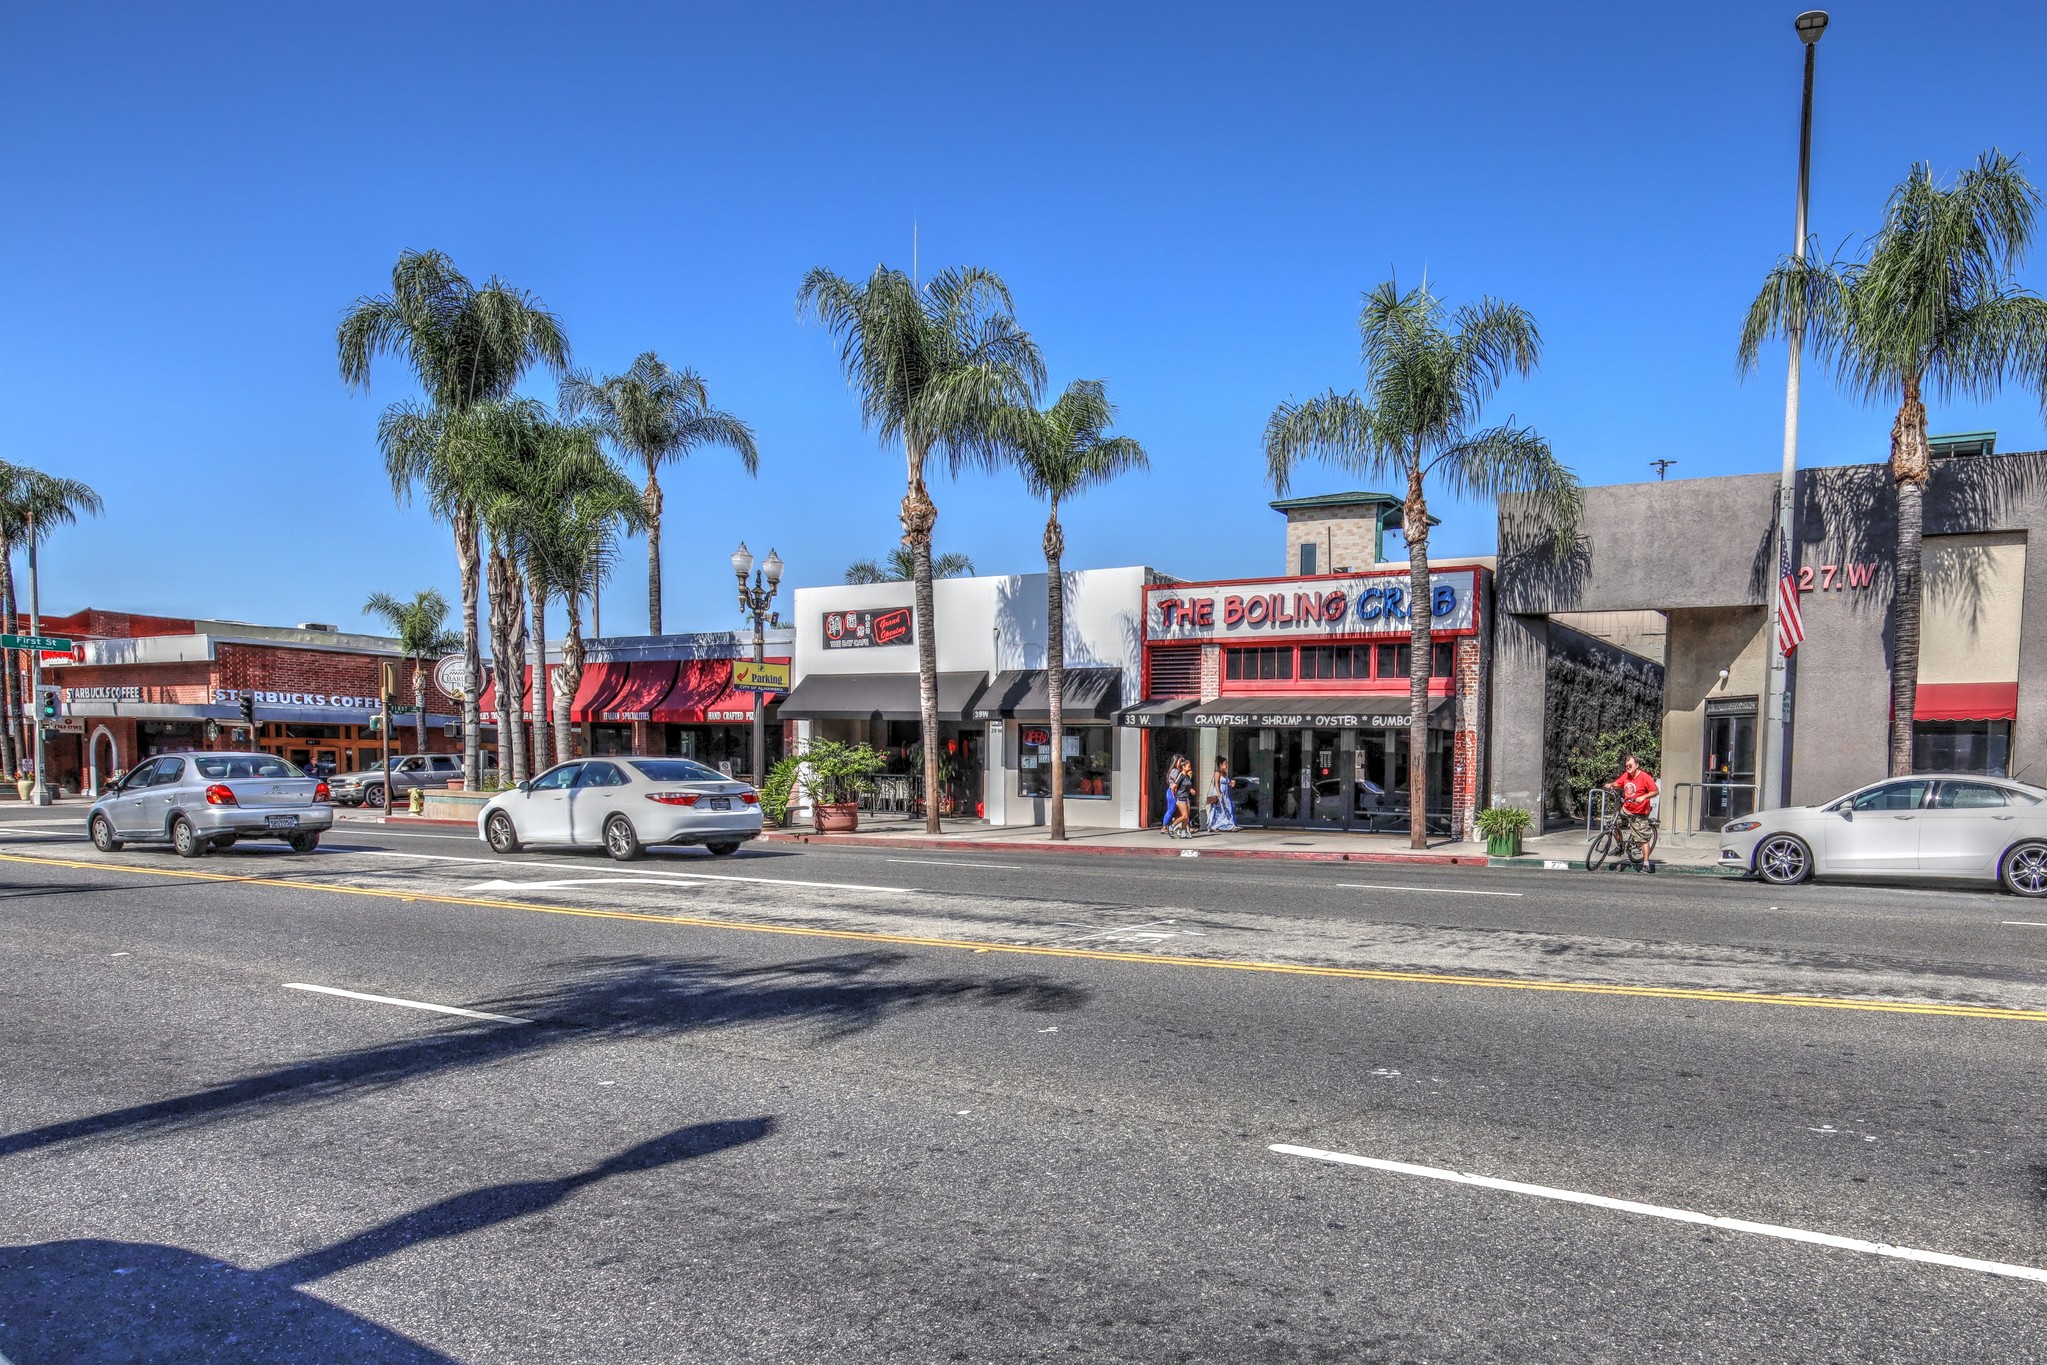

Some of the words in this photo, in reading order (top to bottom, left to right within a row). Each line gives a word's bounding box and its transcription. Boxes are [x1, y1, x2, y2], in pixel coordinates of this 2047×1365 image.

[1156, 597, 1214, 627] THE
[1223, 590, 1347, 624] BOILING
[1356, 585, 1457, 620] CRB
[879, 614, 900, 630] Grand
[880, 626, 906, 639] Opening
[16, 636, 41, 646] First
[45, 638, 57, 647] St
[829, 640, 841, 648] THE
[751, 673, 783, 685] Parking
[66, 687, 111, 699] STARBUCKS
[111, 686, 140, 698] COFFEE
[215, 688, 326, 706] STRBUCKS
[330, 695, 382, 709] COFFE
[707, 711, 721, 720] HAND
[722, 711, 744, 720] CRAFTED
[974, 710, 989, 718] 39W
[1124, 714, 1136, 725] 33
[1139, 714, 1151, 725] W.
[1194, 714, 1249, 725] CRAWFISH
[1261, 715, 1302, 726] SHRIMP
[1315, 715, 1358, 726] OYSTER
[1371, 715, 1412, 727] GUMBO
[1023, 730, 1047, 743] OPEN
